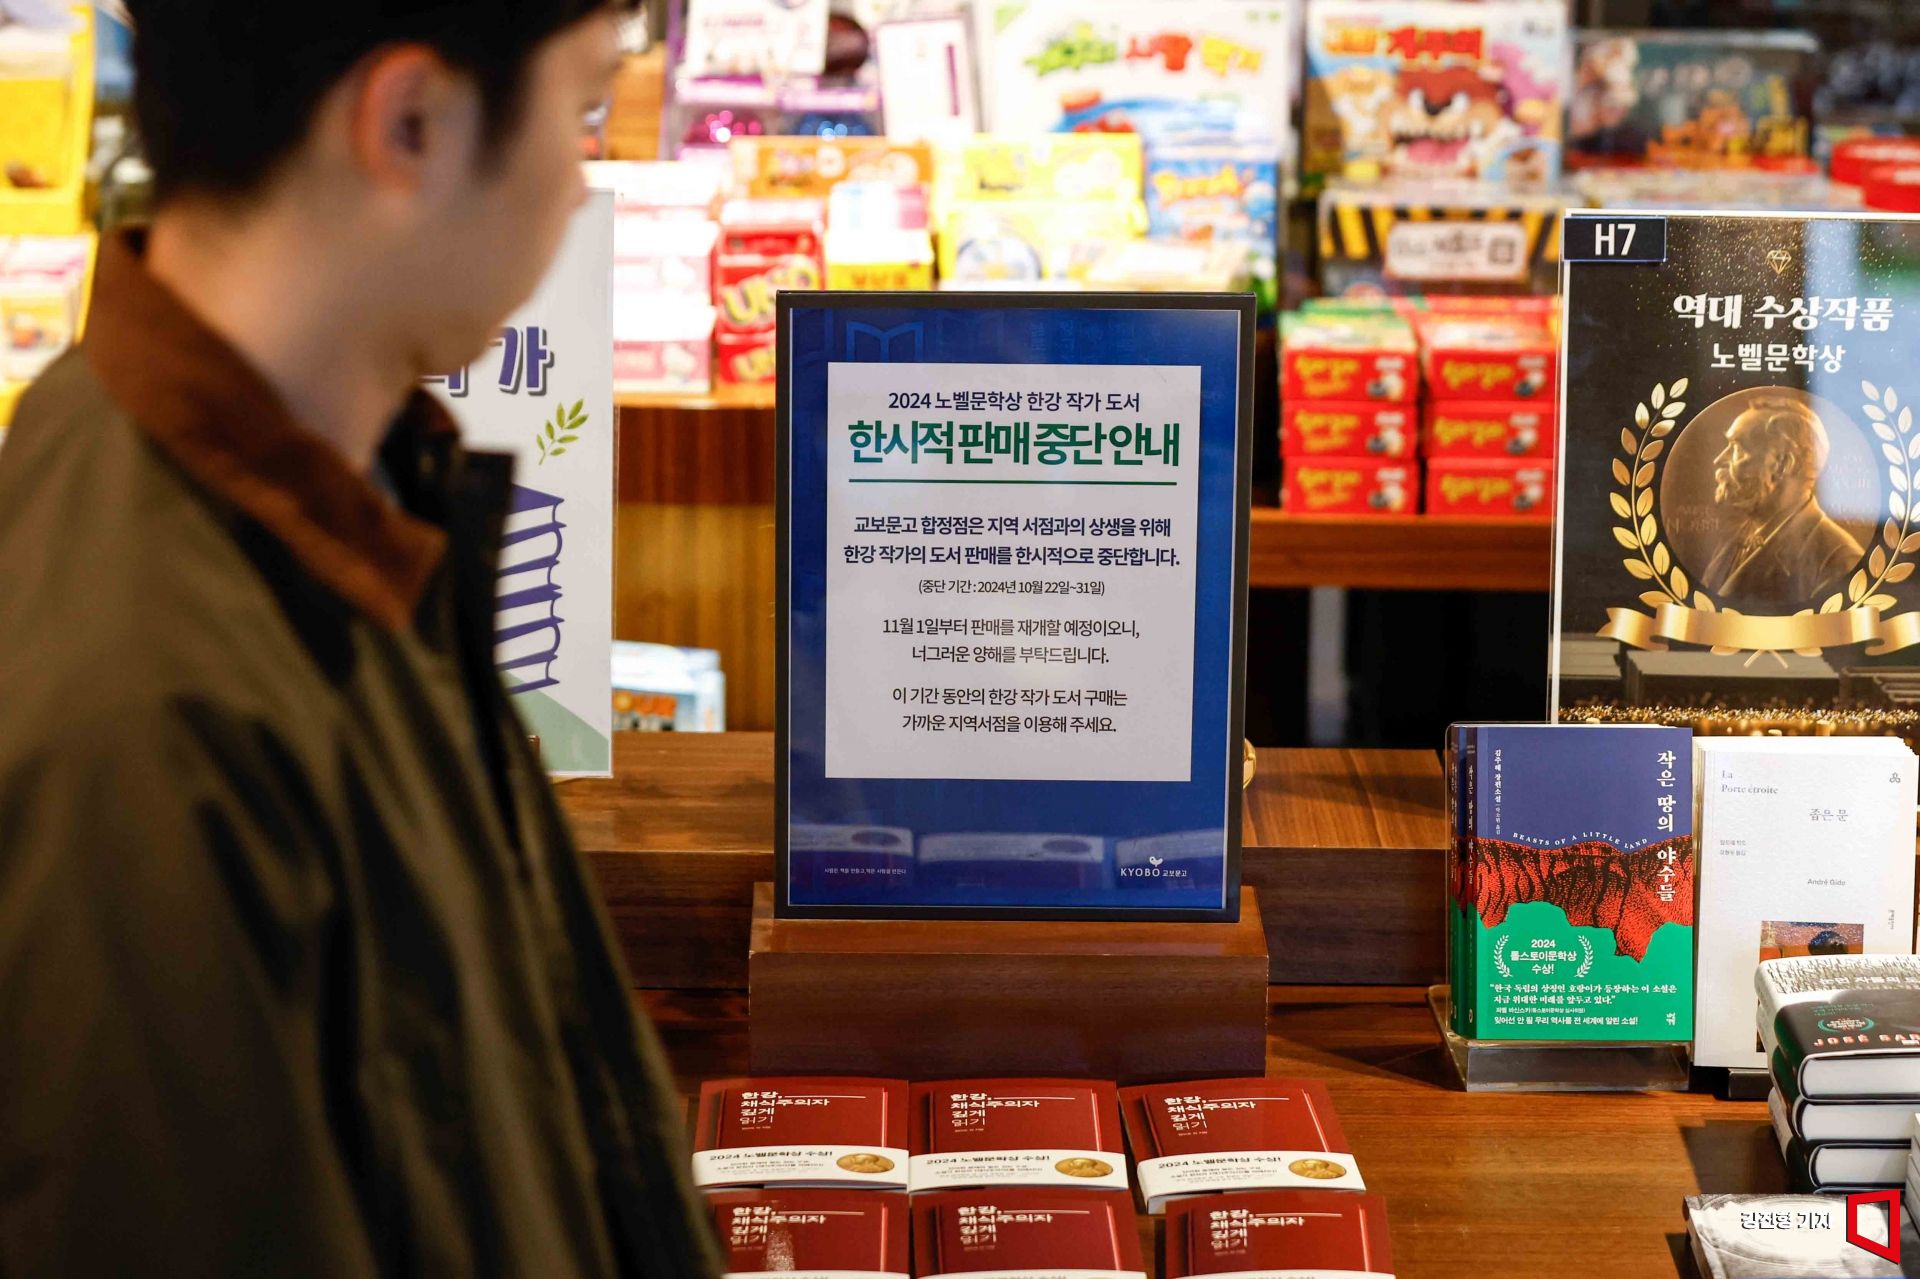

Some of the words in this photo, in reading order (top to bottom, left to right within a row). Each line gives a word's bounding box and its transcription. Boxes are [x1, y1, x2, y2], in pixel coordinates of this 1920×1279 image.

[1595, 223, 1637, 256] H7
[1673, 293, 1743, 329] 역대
[1753, 295, 1894, 331] 수상작품
[1711, 343, 1847, 373] 노벨문학상
[889, 393, 931, 408] 2024
[935, 391, 1022, 411] 노벨문학상
[1027, 392, 1062, 411] 한강
[1067, 393, 1101, 412] 작가
[1106, 393, 1139, 412] 도서
[848, 420, 953, 464] 한시적
[958, 421, 1029, 465] 판매
[1034, 423, 1107, 465] 중단
[1109, 423, 1179, 466] 안내
[854, 517, 917, 534] 교보문고
[921, 516, 984, 535] 합정점은
[988, 517, 1018, 535] 지역
[1023, 517, 1084, 536] 서점과의
[1089, 518, 1136, 536] 상생을
[1139, 518, 1170, 537] 위해
[844, 545, 876, 563] 한강
[879, 545, 925, 564] 작가의
[930, 546, 960, 564] 도서
[965, 546, 1012, 564] 판매를
[1016, 547, 1094, 565] 한시적으로
[1097, 548, 1179, 566] 중단합니다.
[919, 580, 946, 594] (중단
[978, 580, 1016, 593] 2024년
[1019, 581, 1042, 594] 10월
[1045, 581, 1104, 596] 22일~31일)
[883, 618, 913, 634] 11월
[917, 619, 967, 635] 1일부터
[971, 619, 1014, 635] 판매를
[1018, 619, 1061, 636] 재개할
[1064, 620, 1139, 638] 예정이오니,
[913, 645, 970, 662] 너그러운
[973, 646, 1016, 663] 양해를
[1020, 647, 1109, 664] 부탁드립니다.
[893, 687, 906, 704] 이
[911, 688, 939, 704] 기간
[942, 689, 984, 705] 동안의
[989, 689, 1018, 705] 한강
[1021, 689, 1050, 705] 작가
[1053, 690, 1080, 706] 도서
[1085, 690, 1127, 706] 구매는
[903, 715, 946, 731] 가까운
[949, 716, 1021, 732] 지역서점을
[1024, 716, 1066, 732] 이용해
[1070, 717, 1116, 733] 주세요.
[1656, 750, 1677, 787] 작은
[1656, 794, 1677, 833] 땅의
[1810, 808, 1834, 822] 좁은
[1836, 808, 1848, 822] 문
[1513, 832, 1550, 846] BEASTS
[1554, 838, 1566, 846] OF
[1582, 831, 1621, 846] LITTLE
[1624, 837, 1648, 850] LAND
[1120, 868, 1160, 877] KYOBO
[1162, 869, 1187, 877] 교보문고
[1657, 846, 1677, 902] 야수들
[1531, 939, 1556, 949] 2024
[1510, 950, 1577, 962] 톨스토이문학상
[1531, 963, 1555, 975] 수상!
[740, 1099, 830, 1107] 채식주의자
[741, 1107, 775, 1116] 깊게
[950, 1100, 1040, 1110] 채식주의자
[1168, 1101, 1256, 1113] 채식주의자
[740, 1116, 773, 1125] 읽기
[951, 1118, 986, 1127] 읽기
[952, 1110, 986, 1118] 깊게
[1170, 1112, 1204, 1122] 깊게
[1172, 1121, 1207, 1131] 읽기
